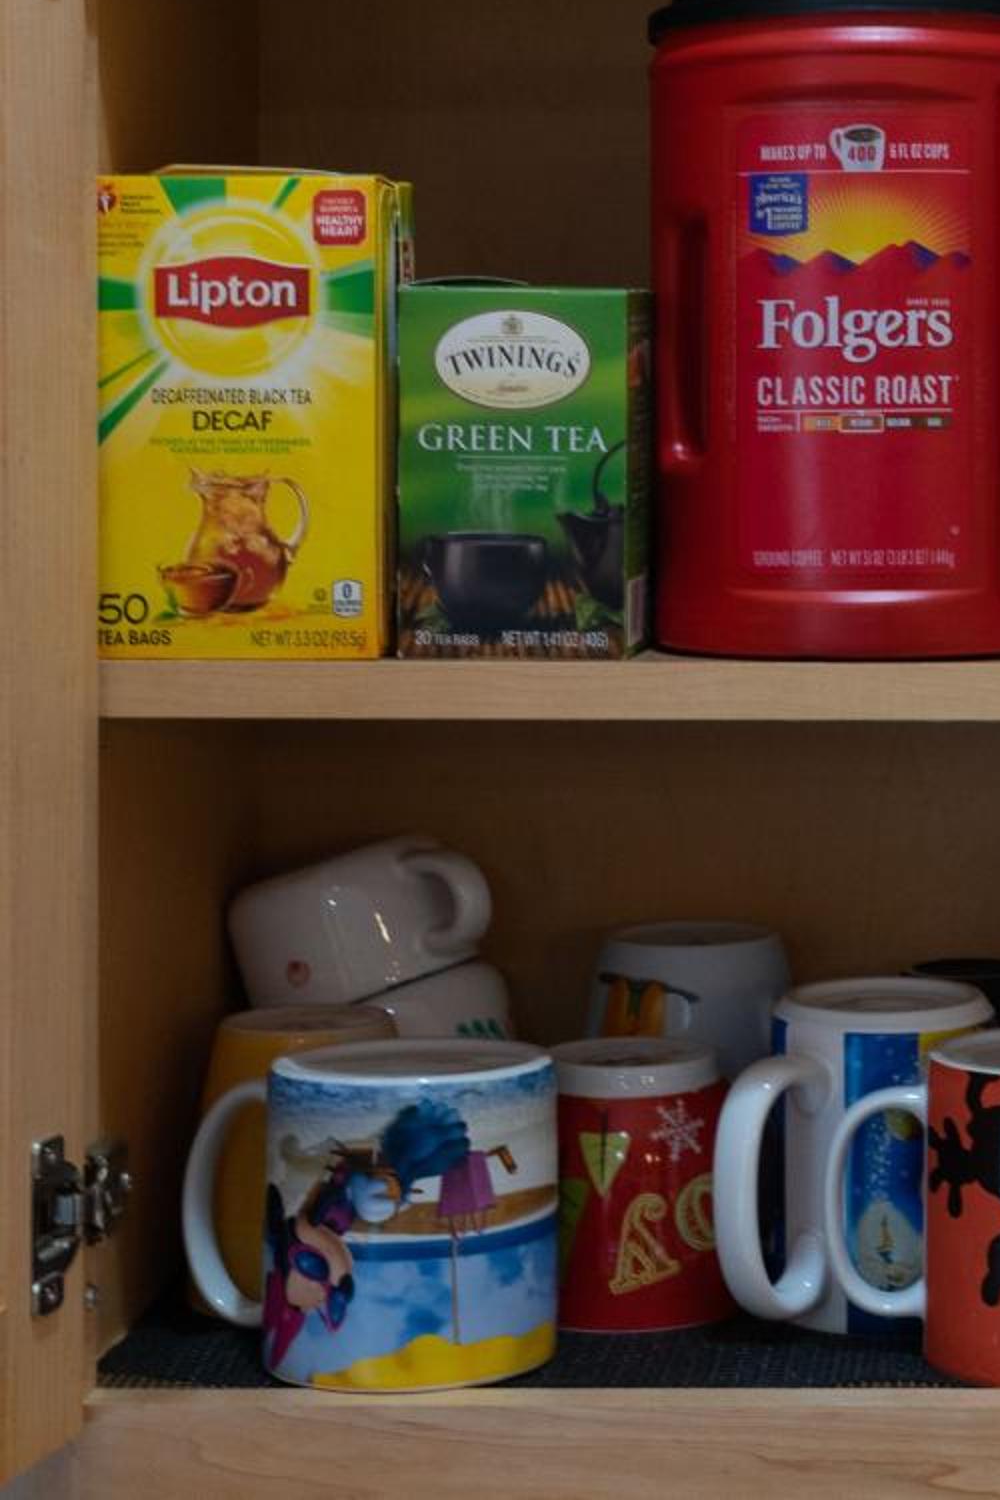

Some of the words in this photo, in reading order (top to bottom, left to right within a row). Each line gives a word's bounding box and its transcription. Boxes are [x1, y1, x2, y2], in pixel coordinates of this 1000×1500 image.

[316, 214, 363, 227] HEALTHY
[320, 225, 358, 238] HEART
[167, 273, 296, 315] Lipton
[757, 294, 955, 363] Folgers
[444, 344, 580, 378] TWININGS
[150, 388, 246, 405] DECAFFEINATED
[249, 388, 287, 405] BLACK
[290, 388, 313, 404] TEA
[757, 375, 866, 406] CLASSIC
[874, 374, 953, 406] ROAST
[192, 409, 273, 432] DECAF
[417, 423, 533, 451] GREEN
[544, 425, 610, 452] TEA
[97, 593, 149, 625] 50
[97, 629, 124, 645] TEA
[128, 629, 173, 646] BAGS
